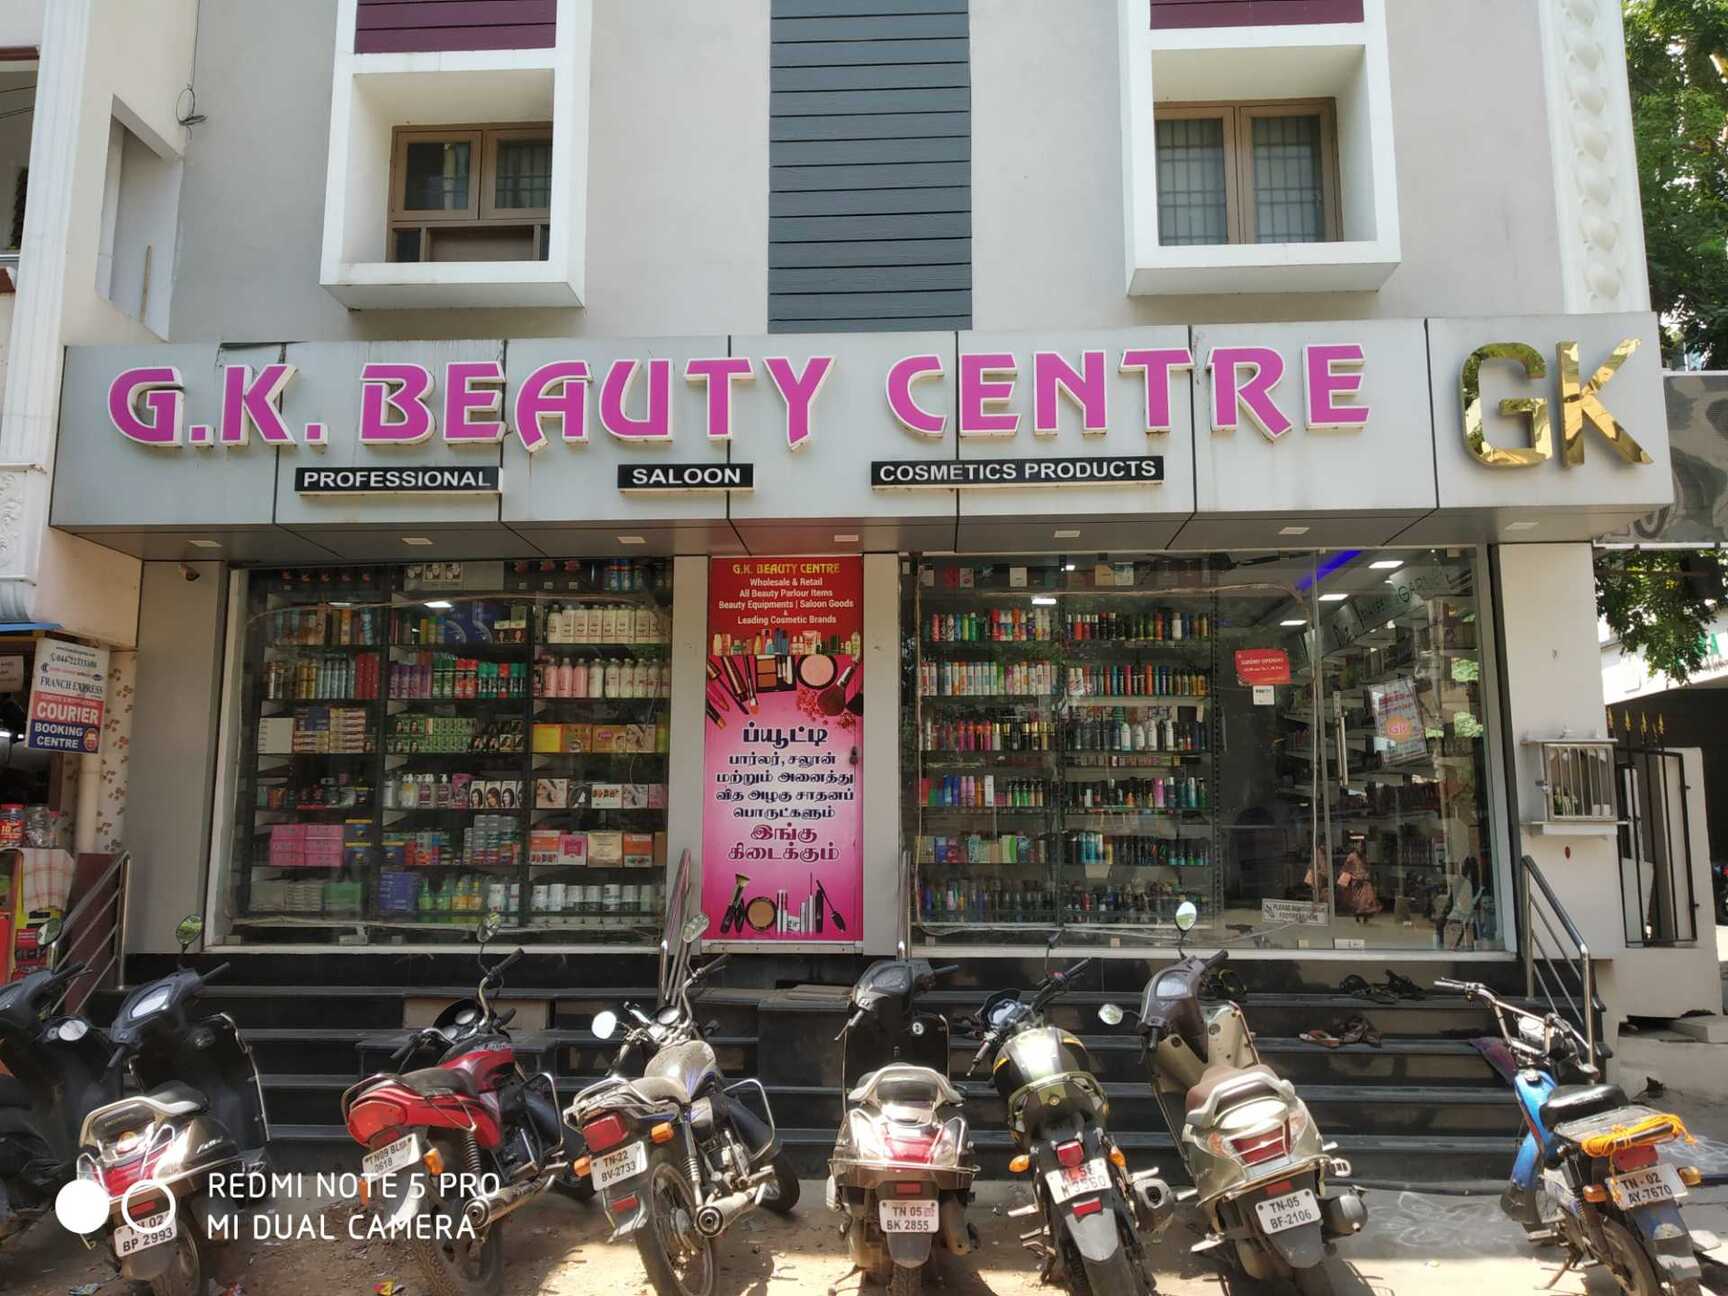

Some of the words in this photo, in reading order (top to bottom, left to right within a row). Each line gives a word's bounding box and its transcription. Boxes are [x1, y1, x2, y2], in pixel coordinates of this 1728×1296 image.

[108, 363, 328, 447] G.K.
[360, 354, 836, 452] BEAUTY
[885, 343, 1371, 443] CENTRE
[1462, 337, 1654, 471] GK
[632, 466, 741, 486] SALOON
[879, 461, 1017, 483] COSMETICS
[1023, 458, 1156, 480] PRODUCTS
[303, 470, 492, 489] PROFESSIONAL
[757, 563, 797, 575] BEAUTY
[800, 562, 841, 574] CENTRE
[749, 577, 791, 587] Wholesale
[791, 577, 799, 587] &
[800, 576, 823, 586] Retail
[739, 589, 750, 598] All
[752, 589, 779, 599] Beauty
[780, 589, 809, 598] Parlour
[811, 588, 833, 597] Items
[719, 600, 746, 611] Beauty
[747, 600, 794, 610] Equipments
[799, 599, 828, 609] Saloon
[828, 599, 855, 608] Goods
[737, 616, 770, 626] Leading
[770, 615, 808, 625] Cosmetic
[809, 615, 837, 624] Brands
[37, 701, 99, 725] COURIER
[34, 722, 84, 737] BOOKING
[743, 721, 829, 749] ப்யூட்டி
[36, 735, 80, 749] CENTRE
[716, 769, 774, 786] மற்றும்
[777, 769, 854, 786] அனைத்து
[750, 821, 818, 844] இங்கு
[728, 841, 841, 863] கிடைக்கும்
[603, 1150, 629, 1168] TN-22
[891, 1206, 907, 1217] TN
[910, 1206, 922, 1217] 05
[1269, 1196, 1300, 1213] TN-05
[886, 1220, 901, 1231] BK
[904, 1220, 929, 1231] 2855
[122, 1238, 139, 1252] BP
[142, 1227, 174, 1247] 2993
